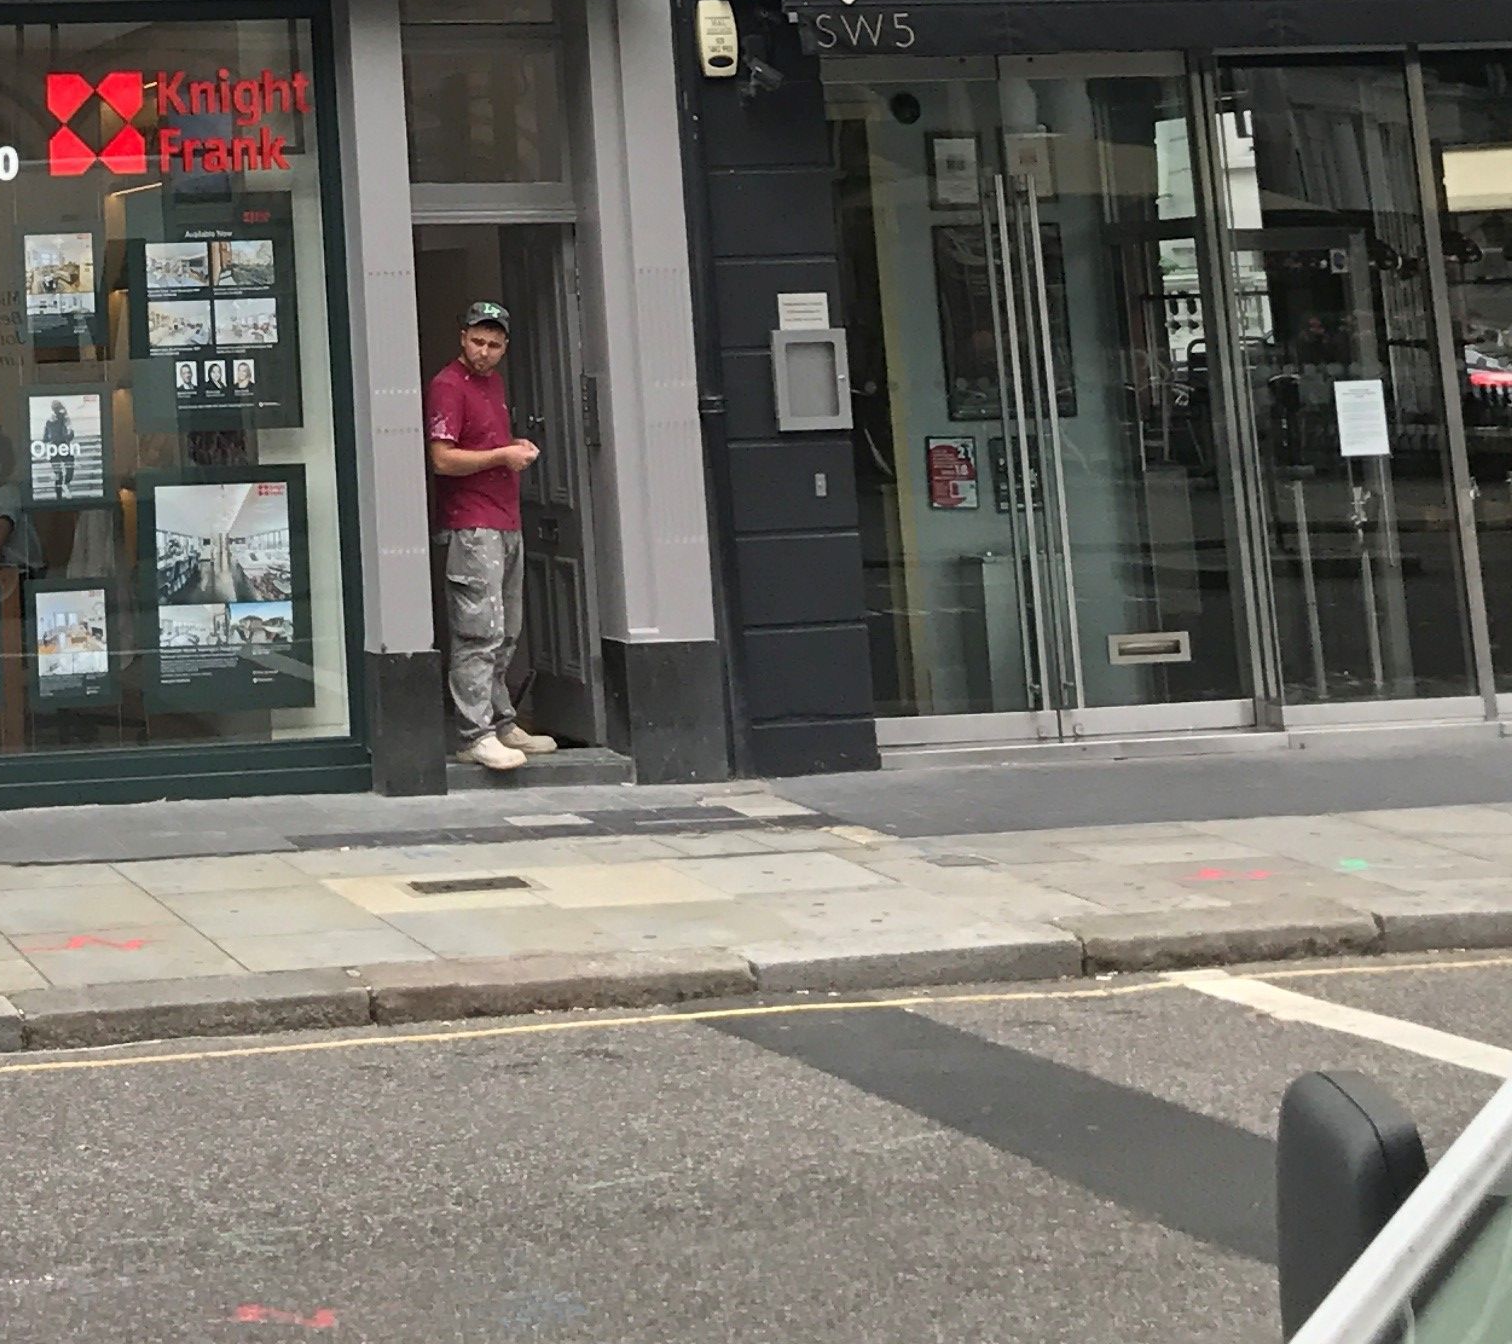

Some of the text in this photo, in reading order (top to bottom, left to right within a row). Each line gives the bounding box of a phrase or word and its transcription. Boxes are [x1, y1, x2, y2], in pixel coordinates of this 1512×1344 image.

[816, 13, 916, 48] SW5
[157, 68, 312, 126] Knight
[159, 127, 290, 173] Frank
[30, 440, 81, 457] Open
